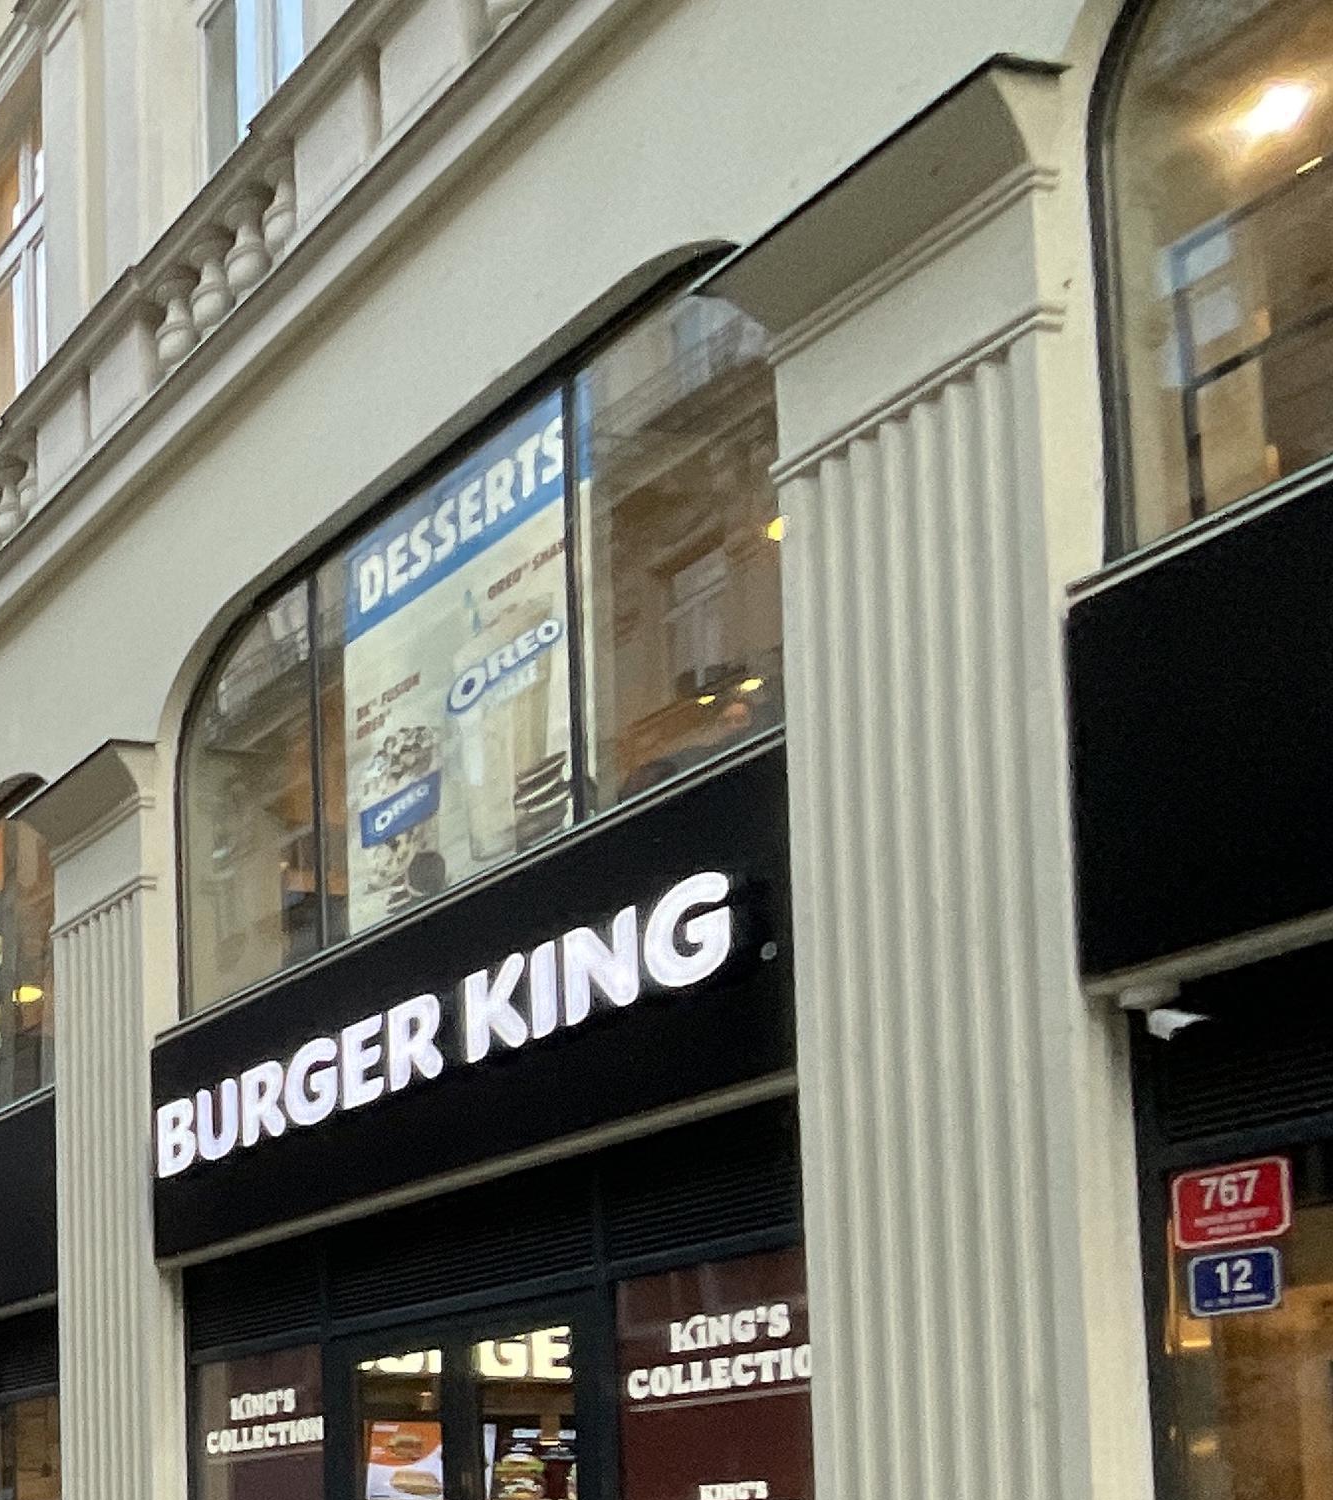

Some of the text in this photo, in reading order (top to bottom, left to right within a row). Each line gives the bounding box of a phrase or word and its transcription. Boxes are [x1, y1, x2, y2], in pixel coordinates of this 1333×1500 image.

[359, 416, 564, 614] DESSERTS
[449, 618, 561, 711] OREO
[156, 871, 732, 1178] BURGER KING
[1199, 1169, 1260, 1210] 767
[1215, 1258, 1253, 1294] 12
[206, 1416, 325, 1454] COLLECTION
